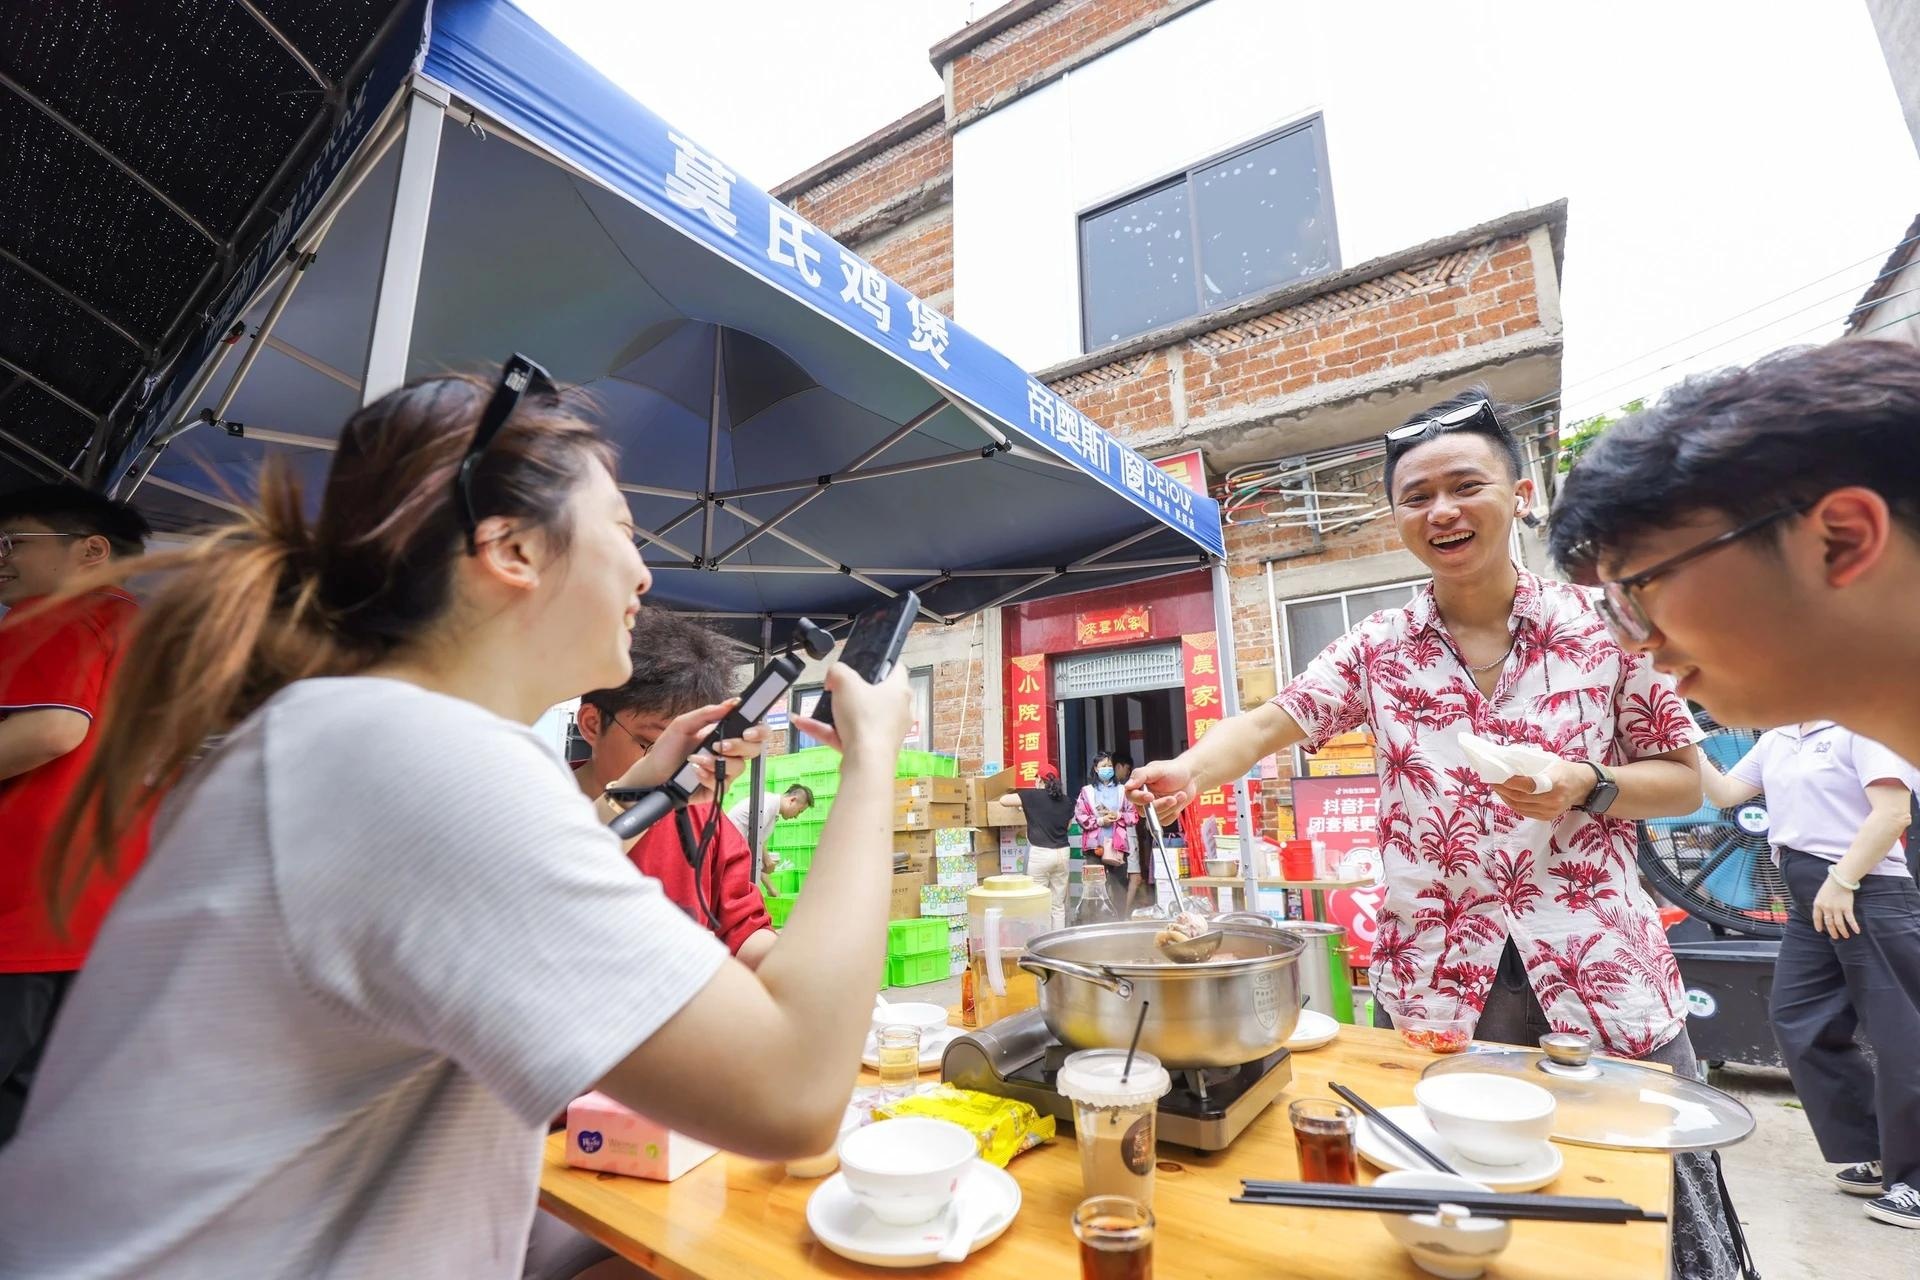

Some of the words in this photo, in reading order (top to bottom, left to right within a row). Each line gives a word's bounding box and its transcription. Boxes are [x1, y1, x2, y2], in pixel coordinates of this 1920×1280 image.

[664, 129, 951, 370] 莫氏鸡煲
[1017, 674, 1041, 782] 小院酒香
